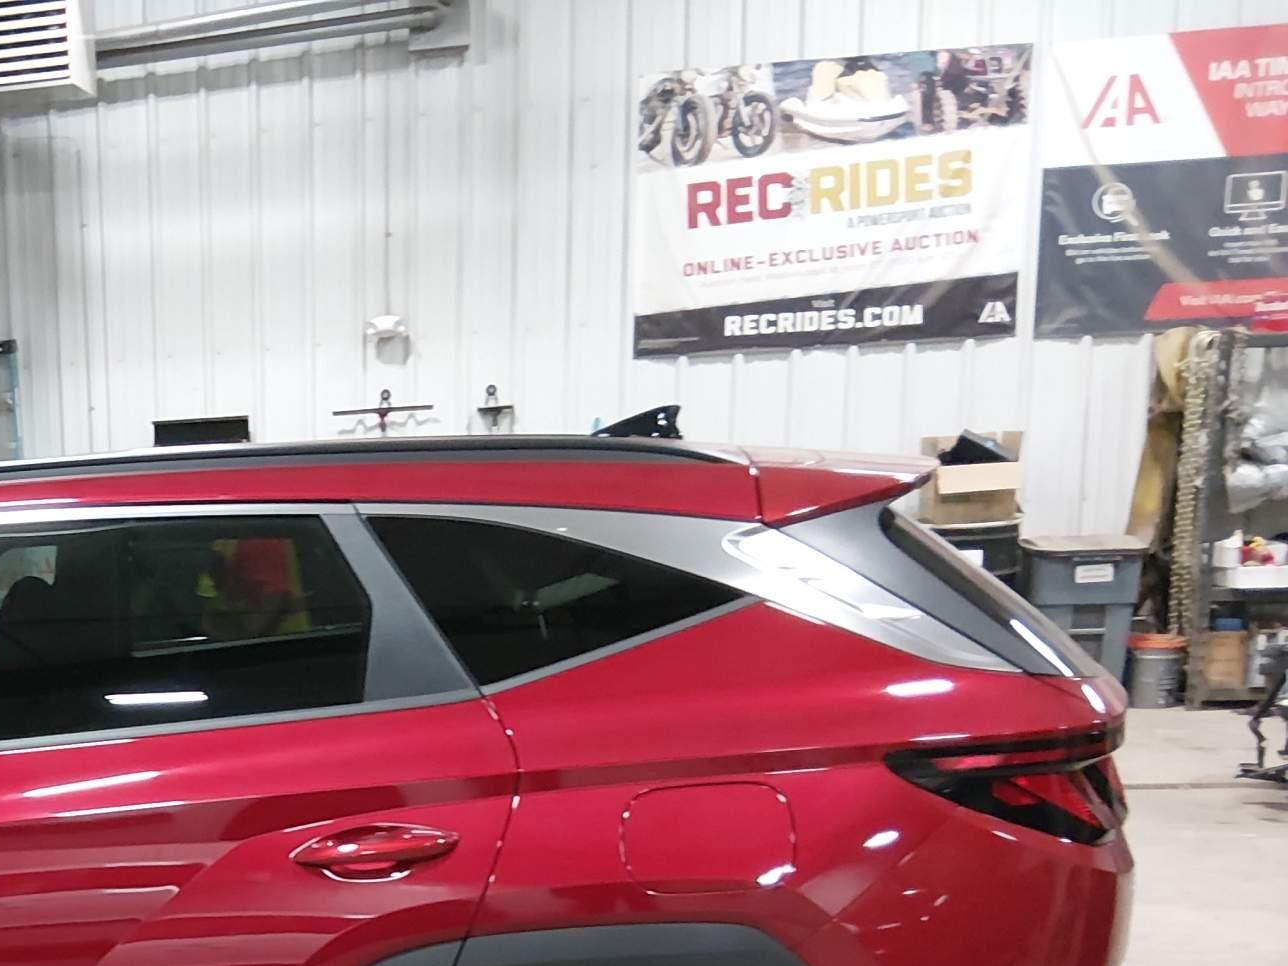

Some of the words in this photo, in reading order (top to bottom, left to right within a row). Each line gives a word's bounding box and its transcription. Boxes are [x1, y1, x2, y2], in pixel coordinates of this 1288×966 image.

[687, 172, 794, 229] REC
[810, 150, 972, 215] RIDES
[682, 240, 883, 278] ONLINE-EXCLUSIVE
[890, 228, 981, 253] AUCTION
[724, 304, 924, 337] RECRIDES.COM
